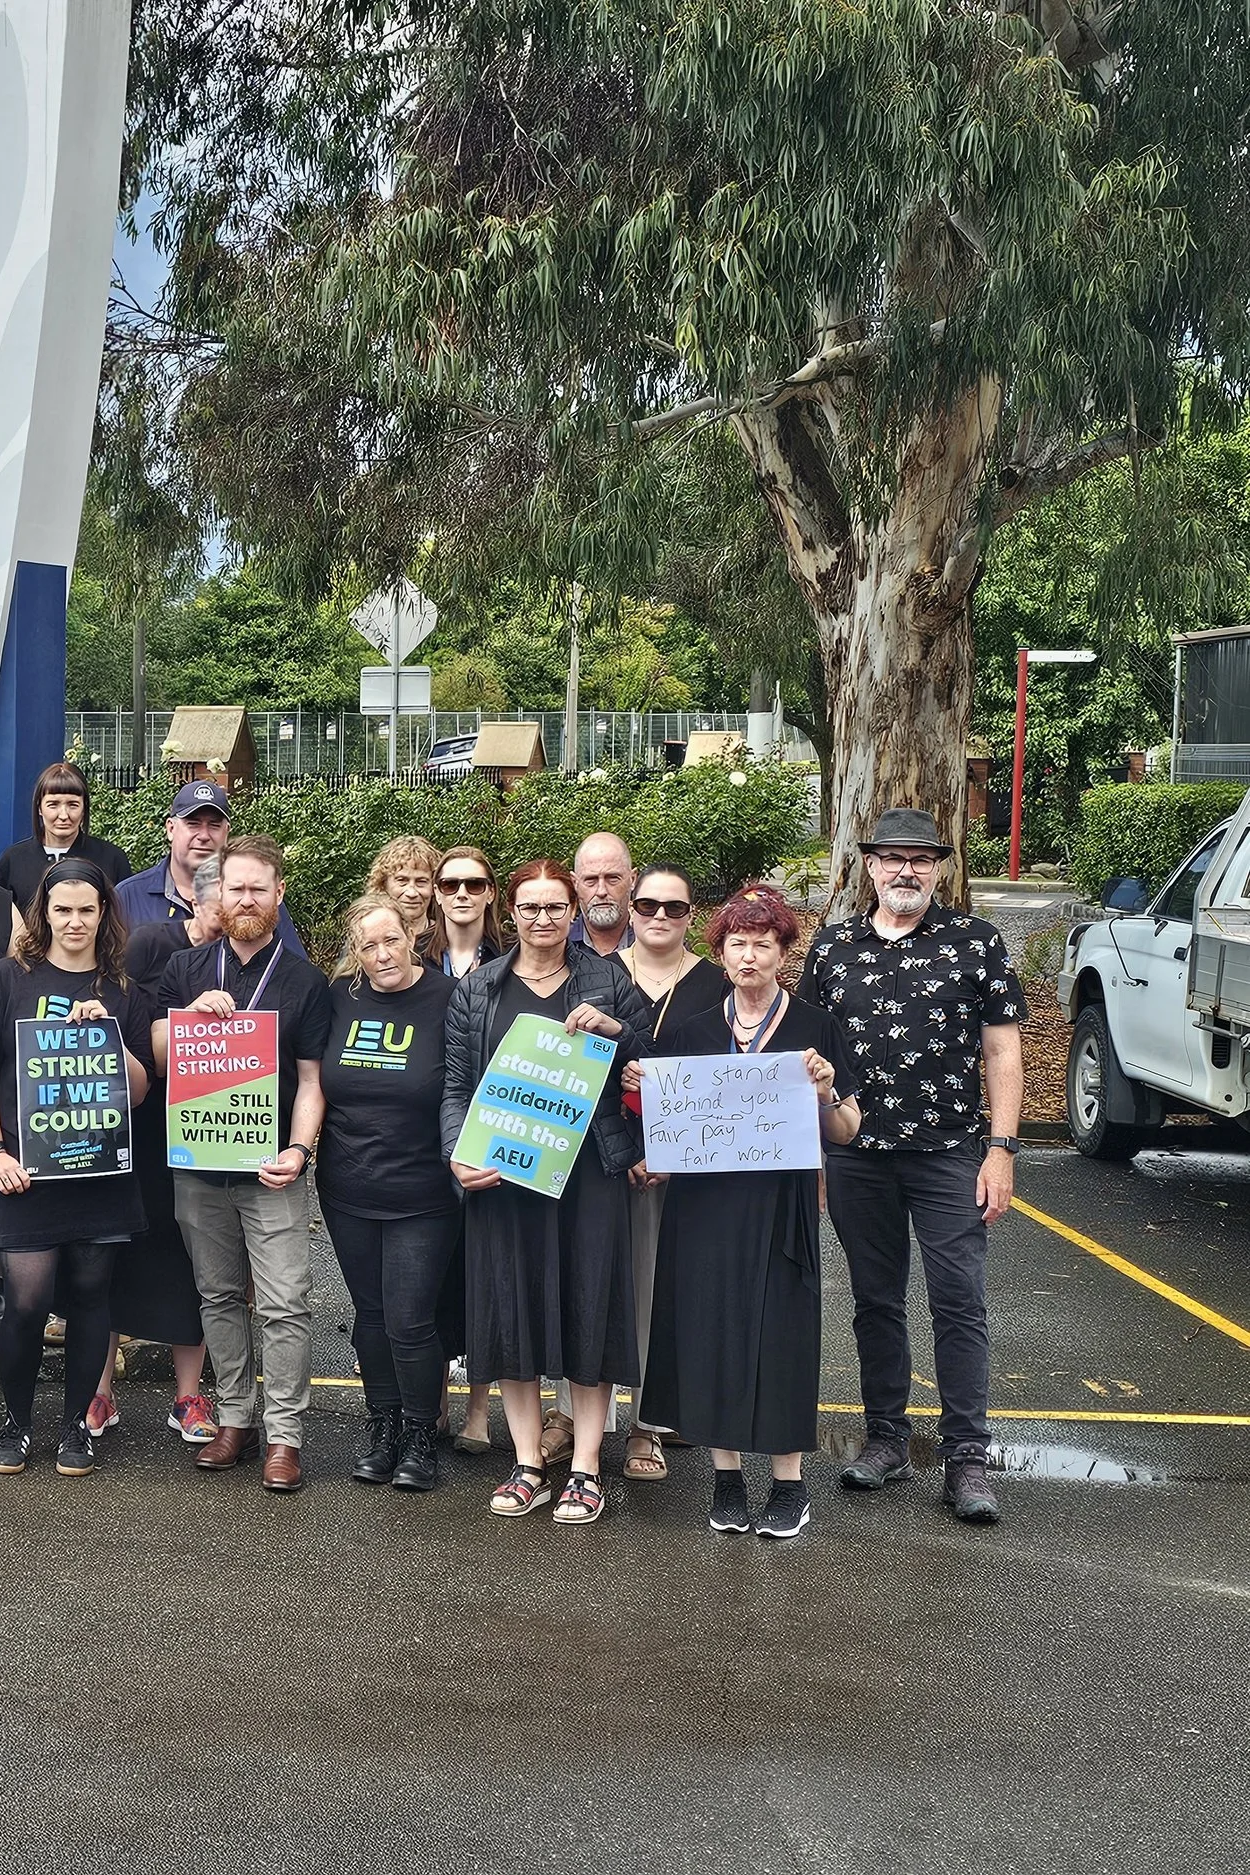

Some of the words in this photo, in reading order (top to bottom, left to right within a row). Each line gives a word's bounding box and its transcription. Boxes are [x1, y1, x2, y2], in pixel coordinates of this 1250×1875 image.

[35, 1027, 107, 1050] WE'D
[174, 1019, 257, 1039] BLOCKED
[345, 1020, 415, 1053] IEU
[175, 1040, 227, 1057] FROM
[535, 1030, 573, 1057] We
[592, 1040, 611, 1053] IEU
[27, 1053, 118, 1079] STRIKE
[177, 1055, 266, 1076] STRIKING.
[498, 1053, 566, 1089] stand
[565, 1071, 590, 1096] in
[654, 1062, 695, 1096] We
[711, 1063, 780, 1087] stand
[38, 1083, 61, 1105] IF
[66, 1081, 110, 1104] WE
[229, 1094, 273, 1108] STILL
[486, 1083, 585, 1126] solidarity
[659, 1092, 725, 1117] Behind
[740, 1091, 789, 1115] you.
[29, 1108, 122, 1133] COULD
[180, 1110, 273, 1126] STANDING
[478, 1107, 528, 1138] with
[531, 1124, 570, 1151] the
[649, 1120, 690, 1144] Fair
[701, 1123, 736, 1147] pay
[754, 1114, 789, 1134] for
[181, 1128, 228, 1143] WITH
[232, 1130, 272, 1144] AEU.
[491, 1145, 534, 1170] AEU
[680, 1146, 719, 1168] fair
[737, 1142, 792, 1162] work.
